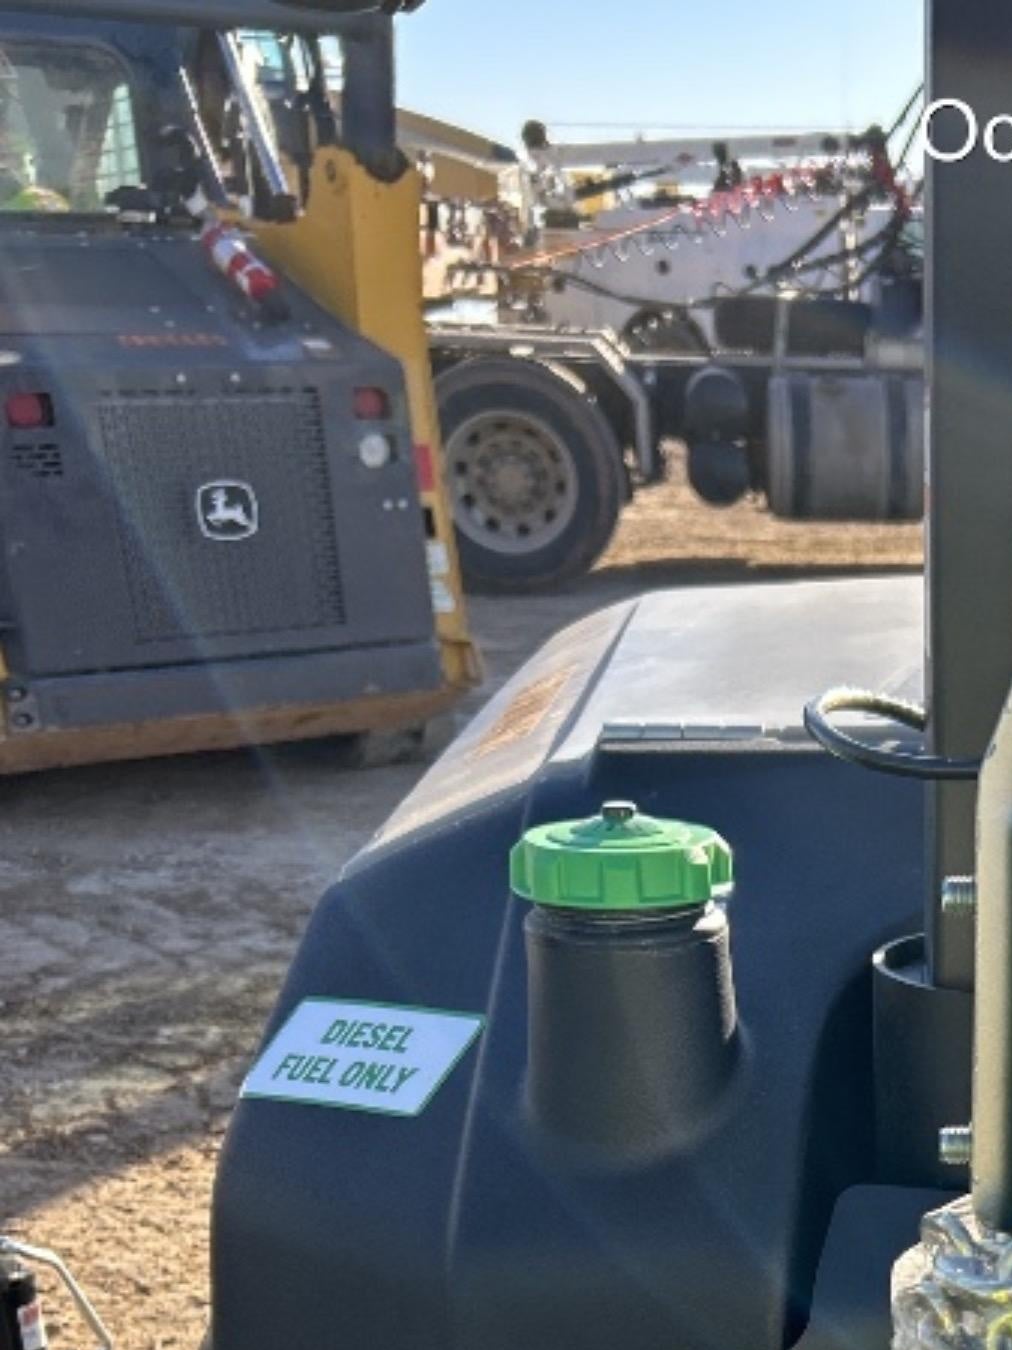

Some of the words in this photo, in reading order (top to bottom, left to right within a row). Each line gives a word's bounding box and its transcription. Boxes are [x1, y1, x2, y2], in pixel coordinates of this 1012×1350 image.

[320, 1019, 414, 1052] DIESEL
[273, 1054, 338, 1084] FUEL
[339, 1061, 420, 1094] ONLY
